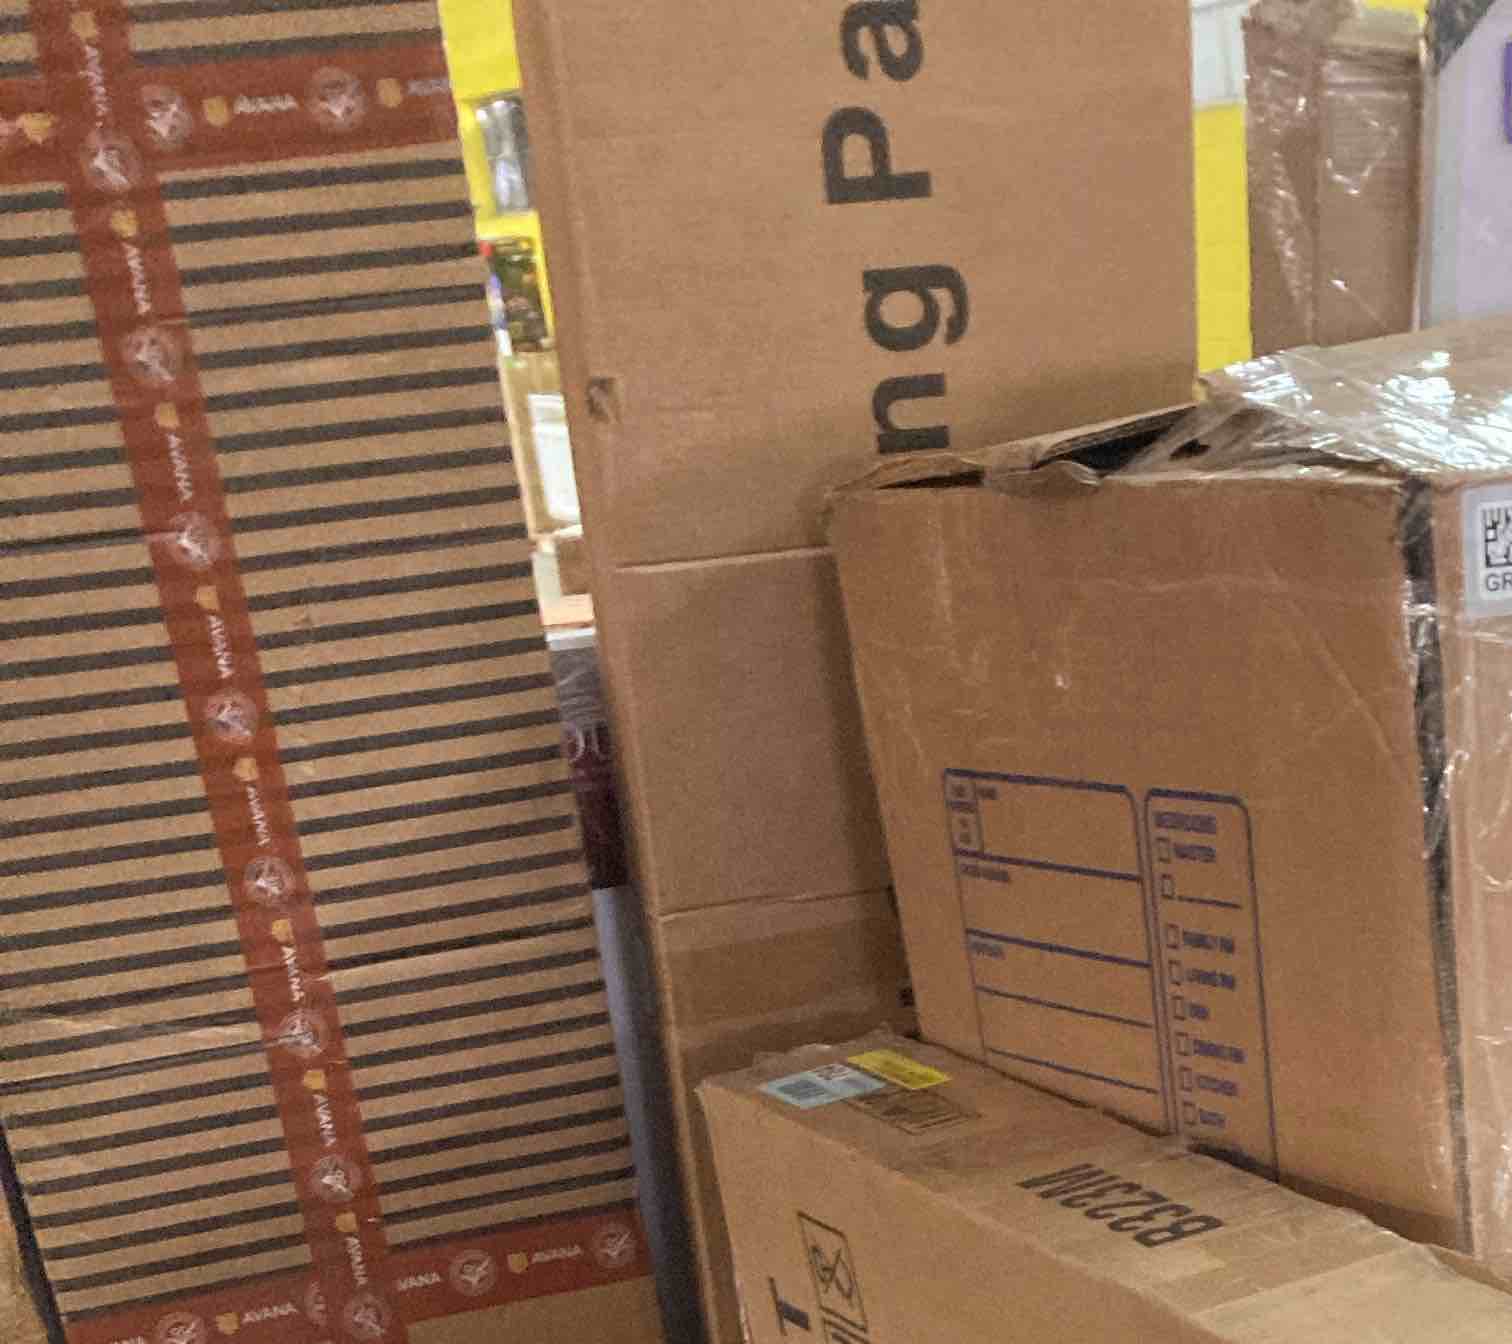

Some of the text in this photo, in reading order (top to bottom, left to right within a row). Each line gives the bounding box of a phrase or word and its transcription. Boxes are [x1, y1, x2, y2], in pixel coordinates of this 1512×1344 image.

[313, 1093, 337, 1149] AVANA
[1015, 1162, 1225, 1249] B323M
[345, 1235, 368, 1289] AVANA
[531, 1245, 583, 1264] AVANA
[243, 1302, 297, 1325] AVANA
